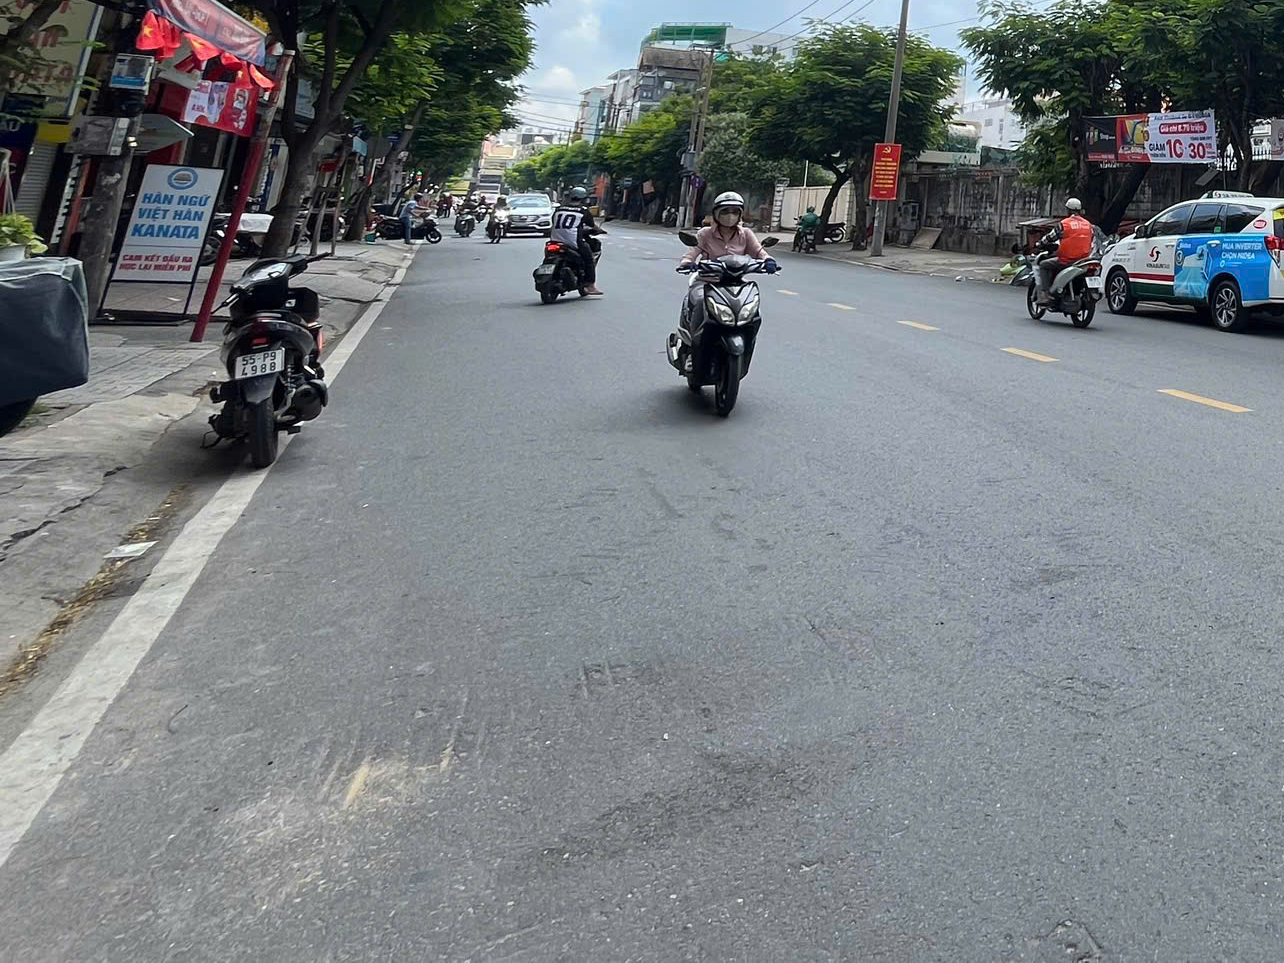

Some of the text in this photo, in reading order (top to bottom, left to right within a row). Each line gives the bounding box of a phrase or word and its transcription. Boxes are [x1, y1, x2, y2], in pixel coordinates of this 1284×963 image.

[141, 192, 174, 205] HÀN
[137, 207, 205, 222] VIỆT HÀN
[555, 213, 576, 229] 10
[131, 223, 200, 239] KANATA
[122, 254, 142, 262] CAM
[144, 252, 160, 262] KẾT
[241, 351, 277, 366] 55-P9
[241, 361, 277, 377] 4988
